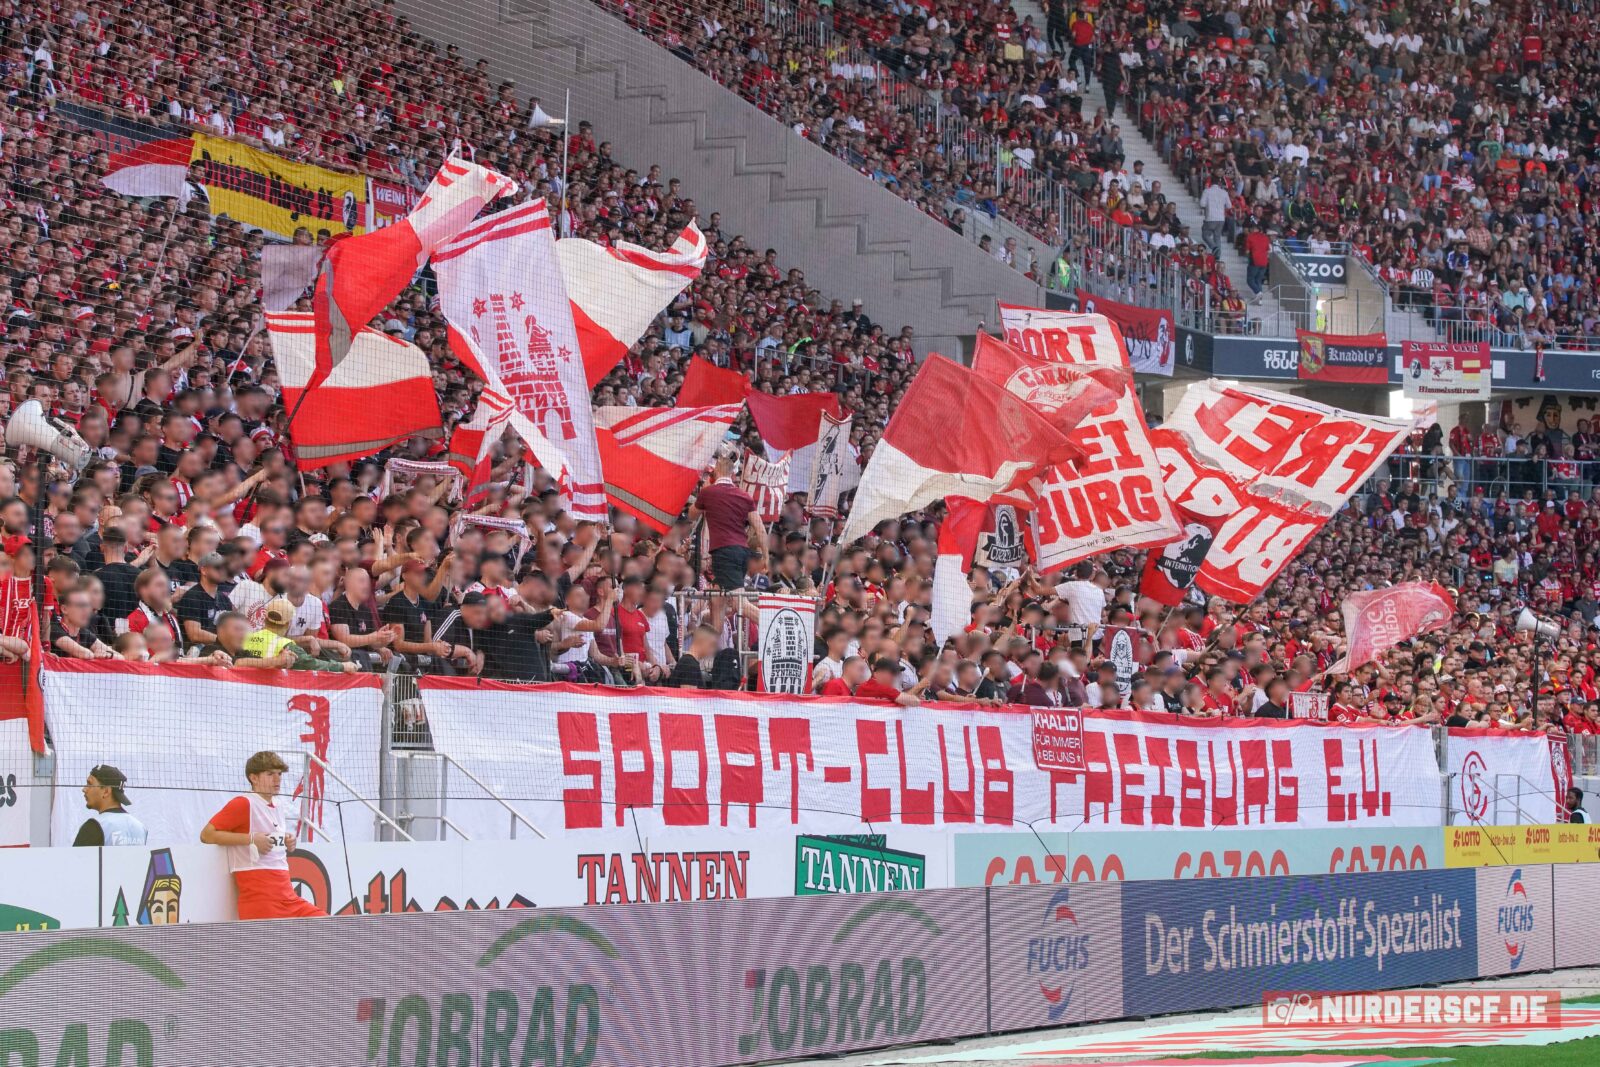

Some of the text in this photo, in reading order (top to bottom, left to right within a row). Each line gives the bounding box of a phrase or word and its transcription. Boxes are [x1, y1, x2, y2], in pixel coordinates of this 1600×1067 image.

[1003, 325, 1097, 363] PORT
[1264, 349, 1288, 361] GET
[1328, 348, 1384, 365] Knaddly's
[1265, 359, 1298, 370] TOUC
[1038, 475, 1162, 545] BURG
[1034, 711, 1078, 731] KHALID
[1051, 735, 1080, 748] IMMER
[1056, 751, 1075, 763] UNS
[1461, 831, 1480, 846] LOTTO
[1533, 828, 1550, 844] LOTTO
[577, 851, 750, 905] TANNEN
[801, 846, 920, 894] TANNEN
[1497, 904, 1535, 934] FUCHS
[1145, 893, 1463, 976] Der Schmierstoff-Spezialist
[1026, 933, 1091, 975] FUCHS
[738, 956, 927, 1056] JOBRAD
[354, 984, 600, 1067] JOBRAD
